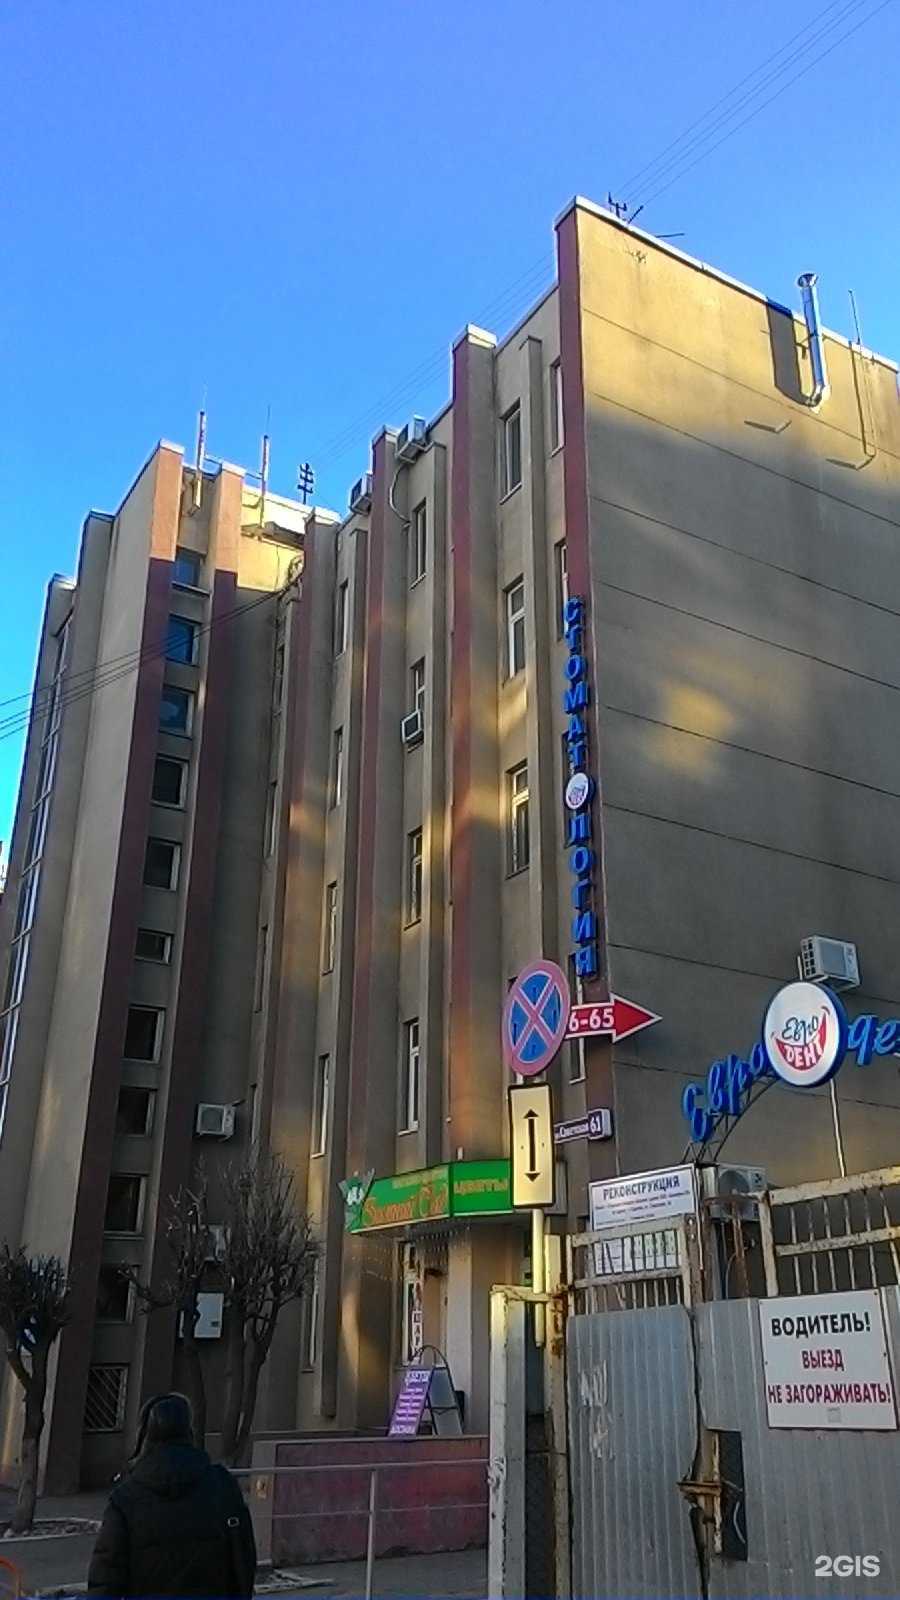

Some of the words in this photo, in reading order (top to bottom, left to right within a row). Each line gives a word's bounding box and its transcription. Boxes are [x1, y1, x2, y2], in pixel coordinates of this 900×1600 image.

[846, 1014, 900, 1067] де
[590, 1116, 601, 1133] 61
[603, 1174, 680, 1201] РЕКОНСТРУКЦИЯ
[771, 1311, 871, 1339] ВОДИТЕЛЬ!
[801, 1348, 845, 1372] ВЫЕЗД
[768, 1384, 783, 1404] НЕ
[785, 1383, 892, 1404] ЗАГОРАЖИВАТЬ!
